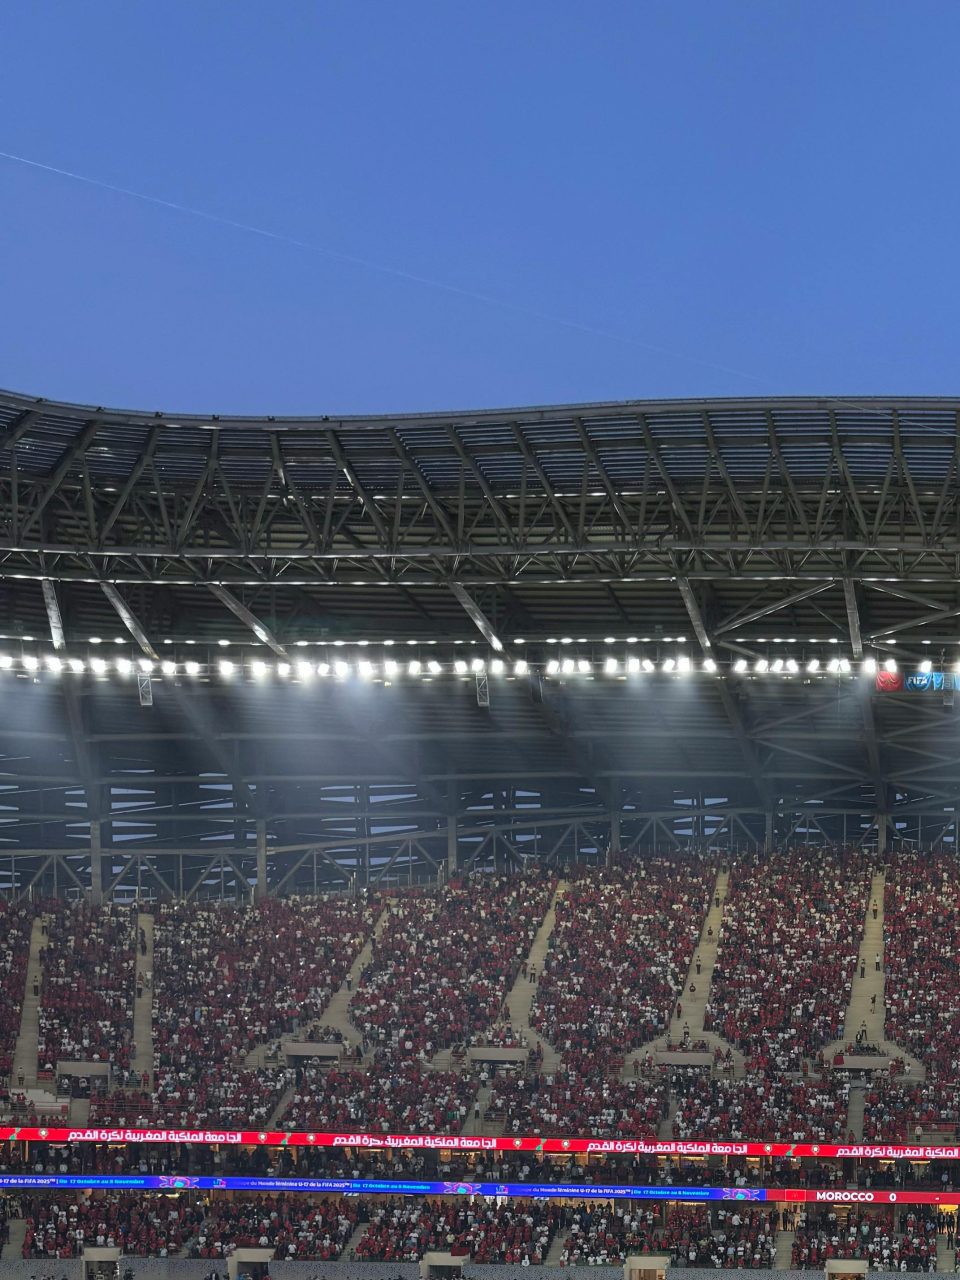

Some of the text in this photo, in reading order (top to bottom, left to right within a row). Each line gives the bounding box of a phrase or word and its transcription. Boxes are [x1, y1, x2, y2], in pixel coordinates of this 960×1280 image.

[908, 676, 928, 684] FIFA
[816, 1192, 874, 1201] MOROCCO
[889, 1193, 896, 1201] 0
